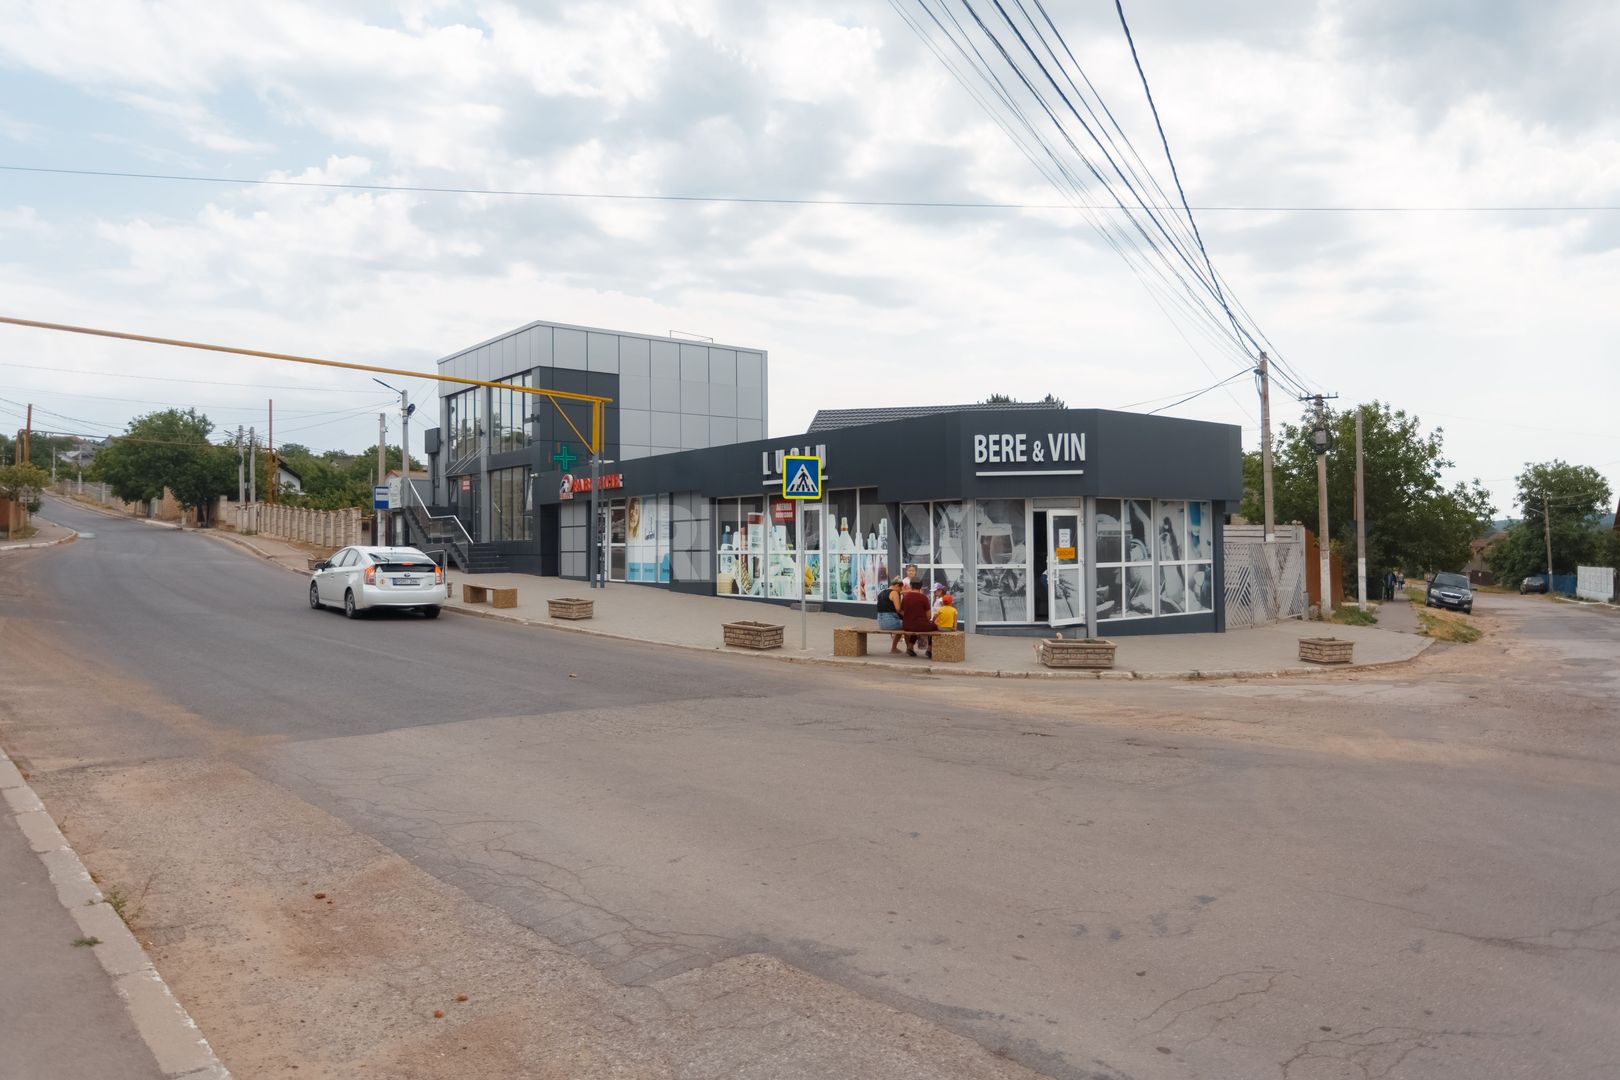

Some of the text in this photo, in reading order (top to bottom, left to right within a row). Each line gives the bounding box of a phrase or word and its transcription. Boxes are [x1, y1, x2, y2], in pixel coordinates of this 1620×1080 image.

[762, 444, 827, 475] LUU
[974, 432, 1086, 463] BERE & VIN
